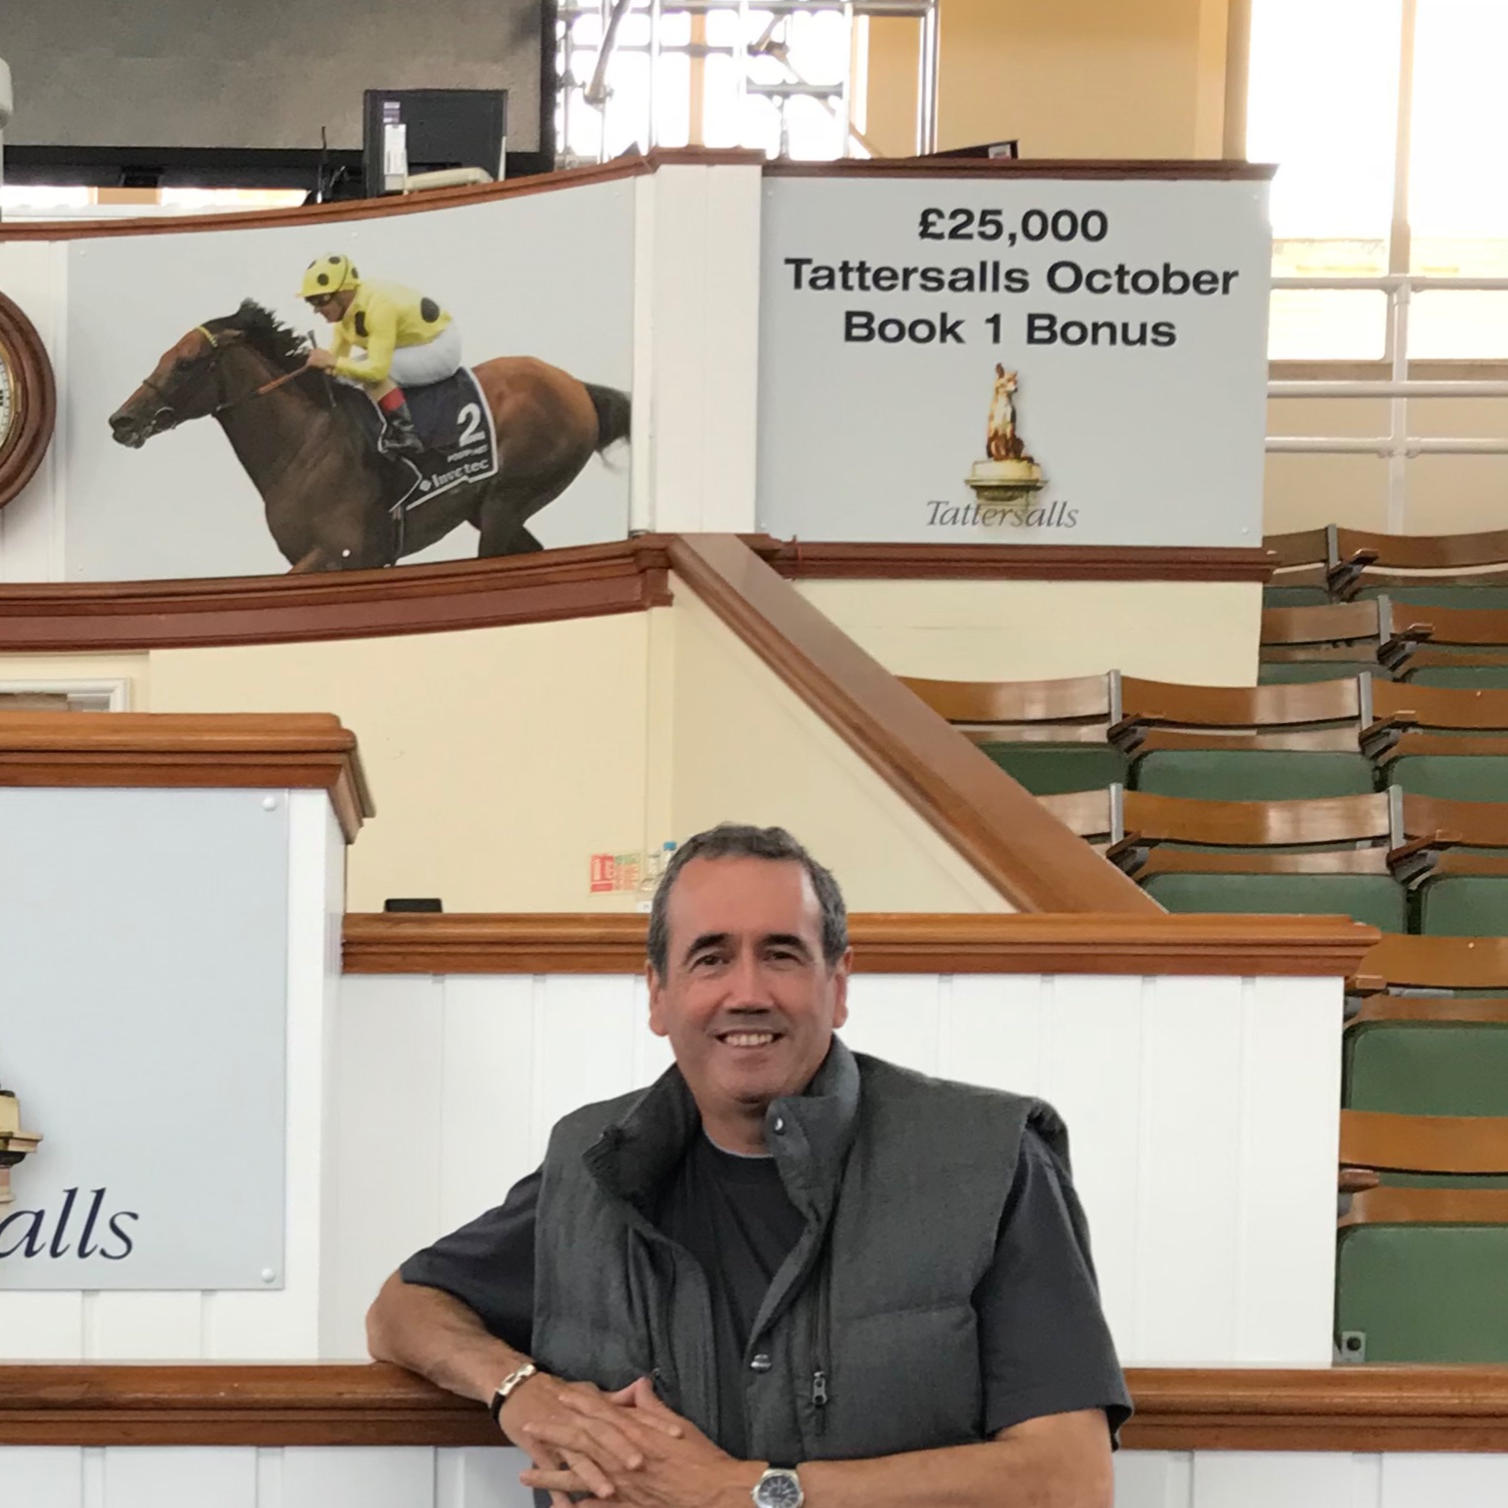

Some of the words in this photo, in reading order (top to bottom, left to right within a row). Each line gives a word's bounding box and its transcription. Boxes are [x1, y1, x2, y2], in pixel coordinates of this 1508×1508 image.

[918, 207, 1109, 246] £25,000
[784, 257, 1030, 293] Tattersalls
[1046, 260, 1240, 296] October
[844, 310, 966, 344] Book
[985, 313, 1002, 344] 1
[1026, 313, 1177, 347] Bonus
[457, 402, 486, 448] 2
[926, 500, 1080, 529] Tattersalls
